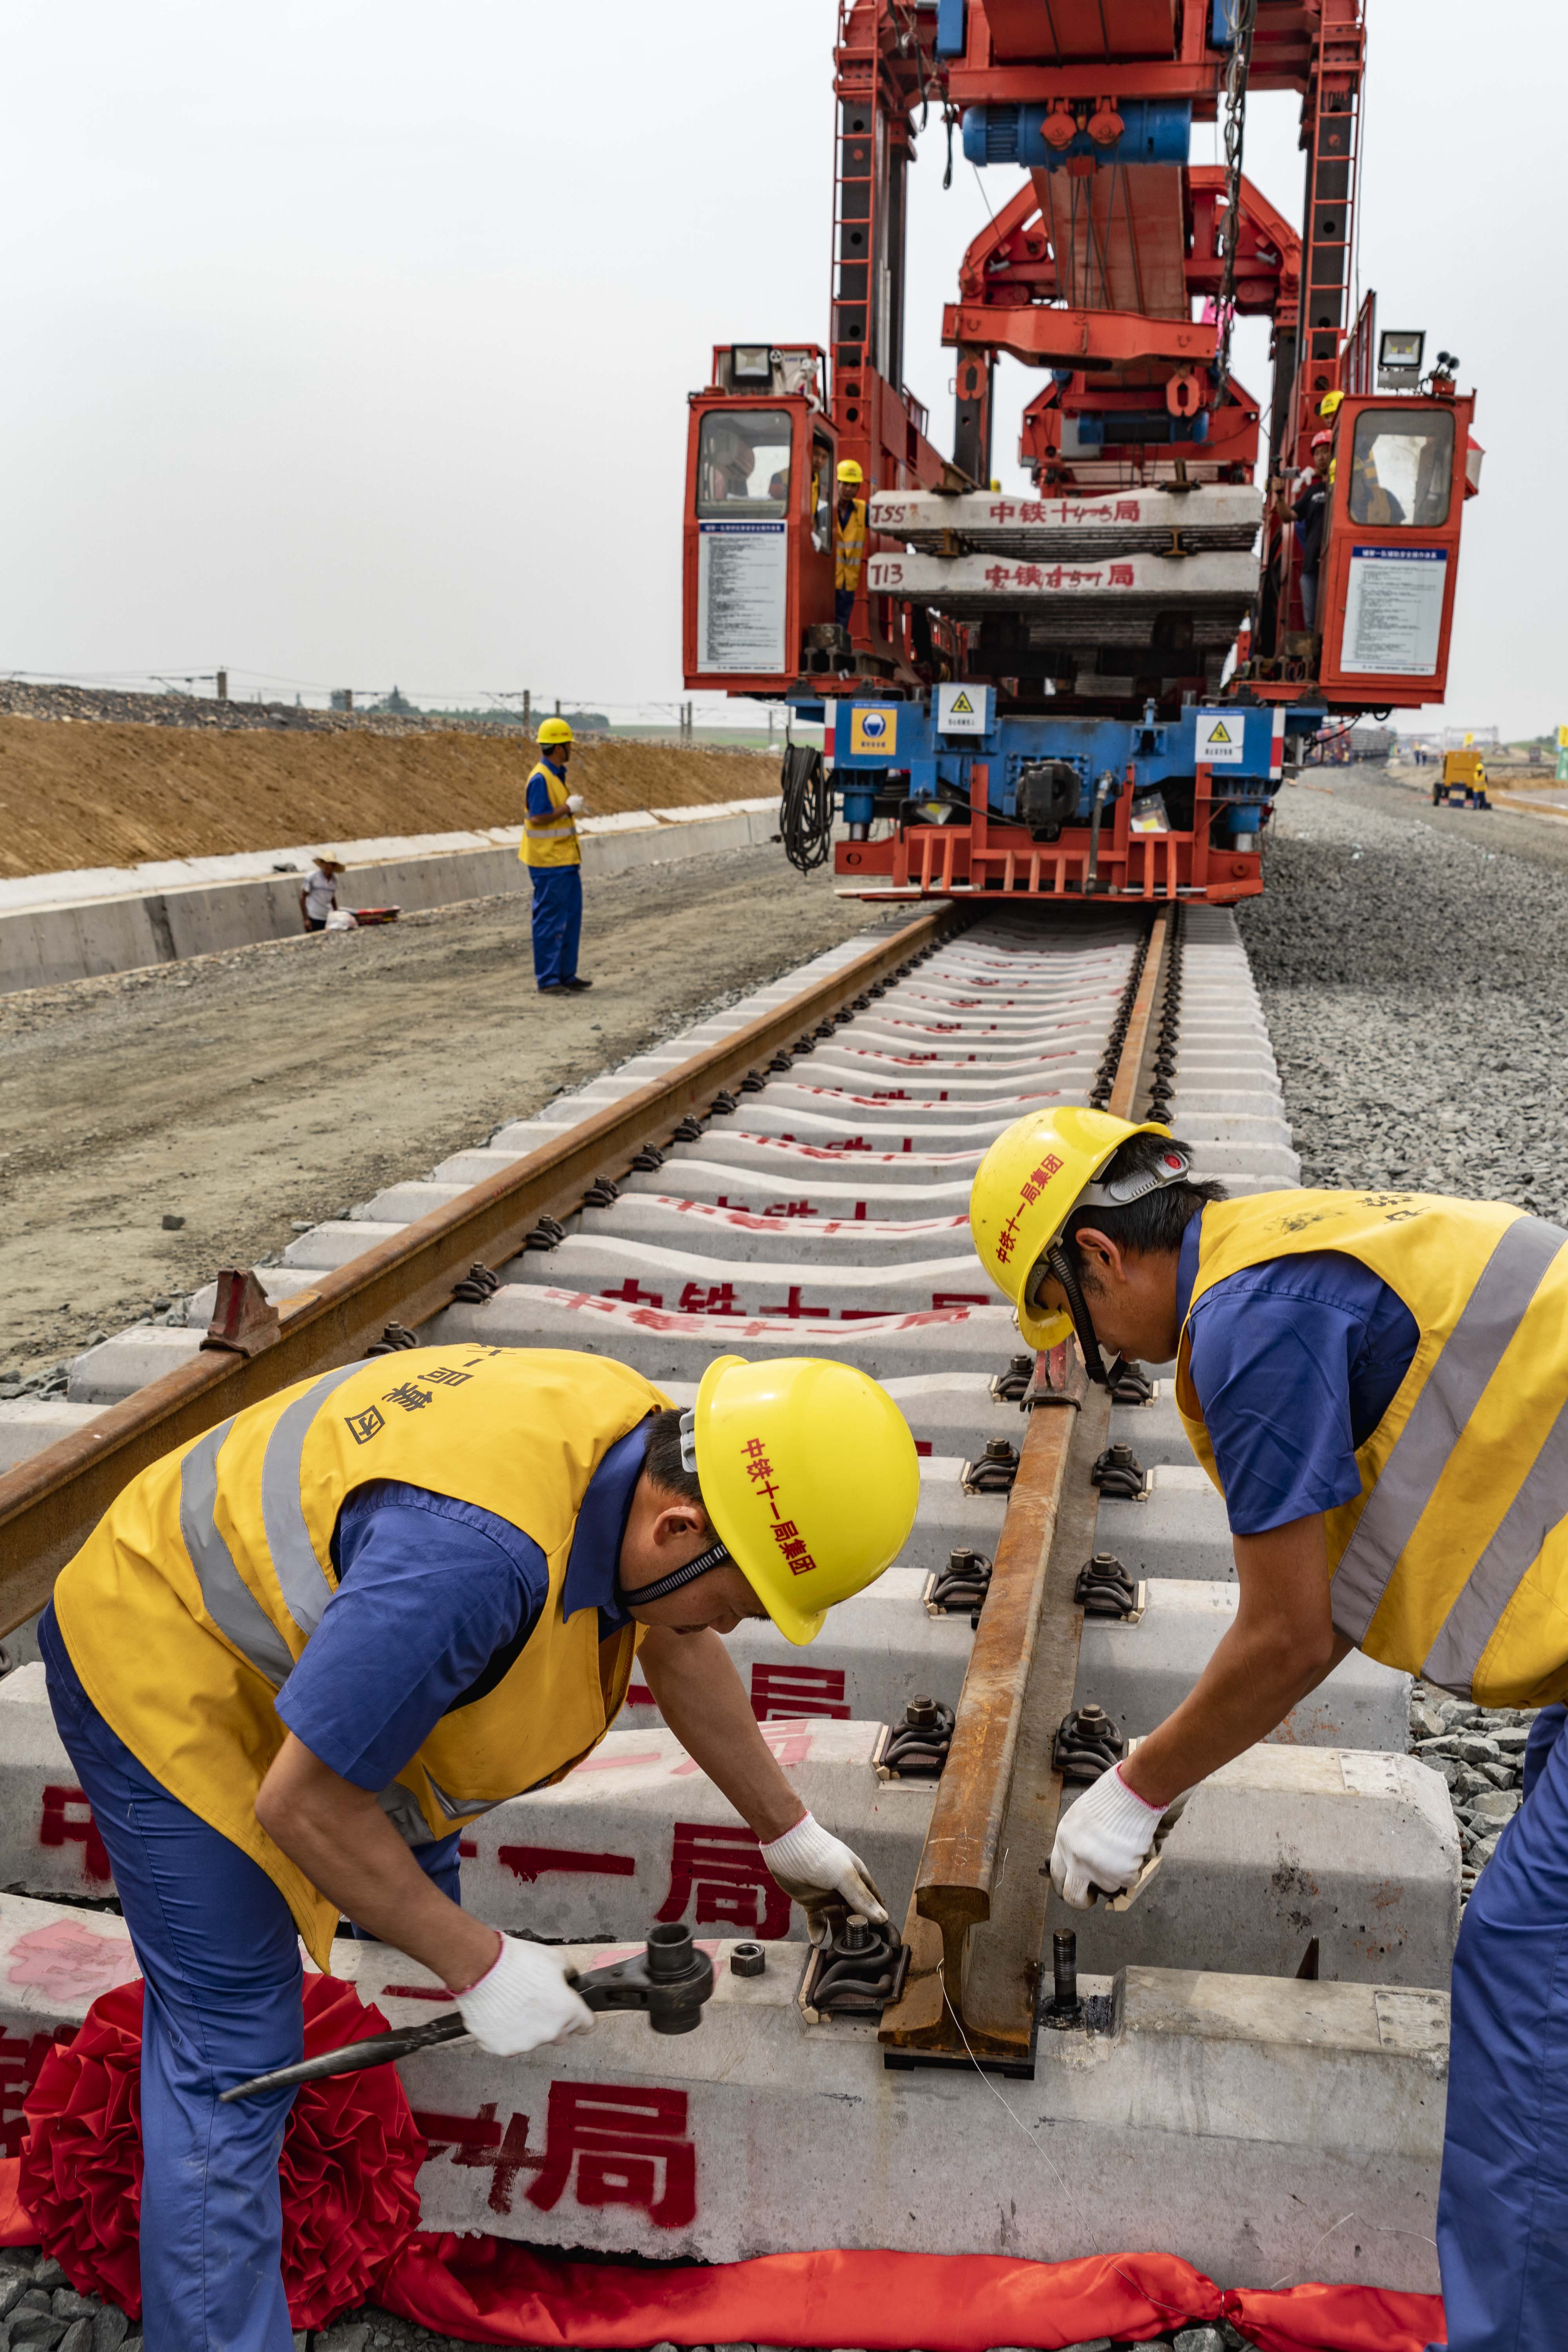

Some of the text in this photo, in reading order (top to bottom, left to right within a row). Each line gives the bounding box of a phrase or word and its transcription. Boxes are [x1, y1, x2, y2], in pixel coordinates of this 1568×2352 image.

[990, 500, 1140, 524] 中铁十一局
[870, 564, 903, 586] T13
[996, 1153, 1064, 1264] 中铁十一局集团
[740, 1437, 817, 1576] 中铁十一局集团
